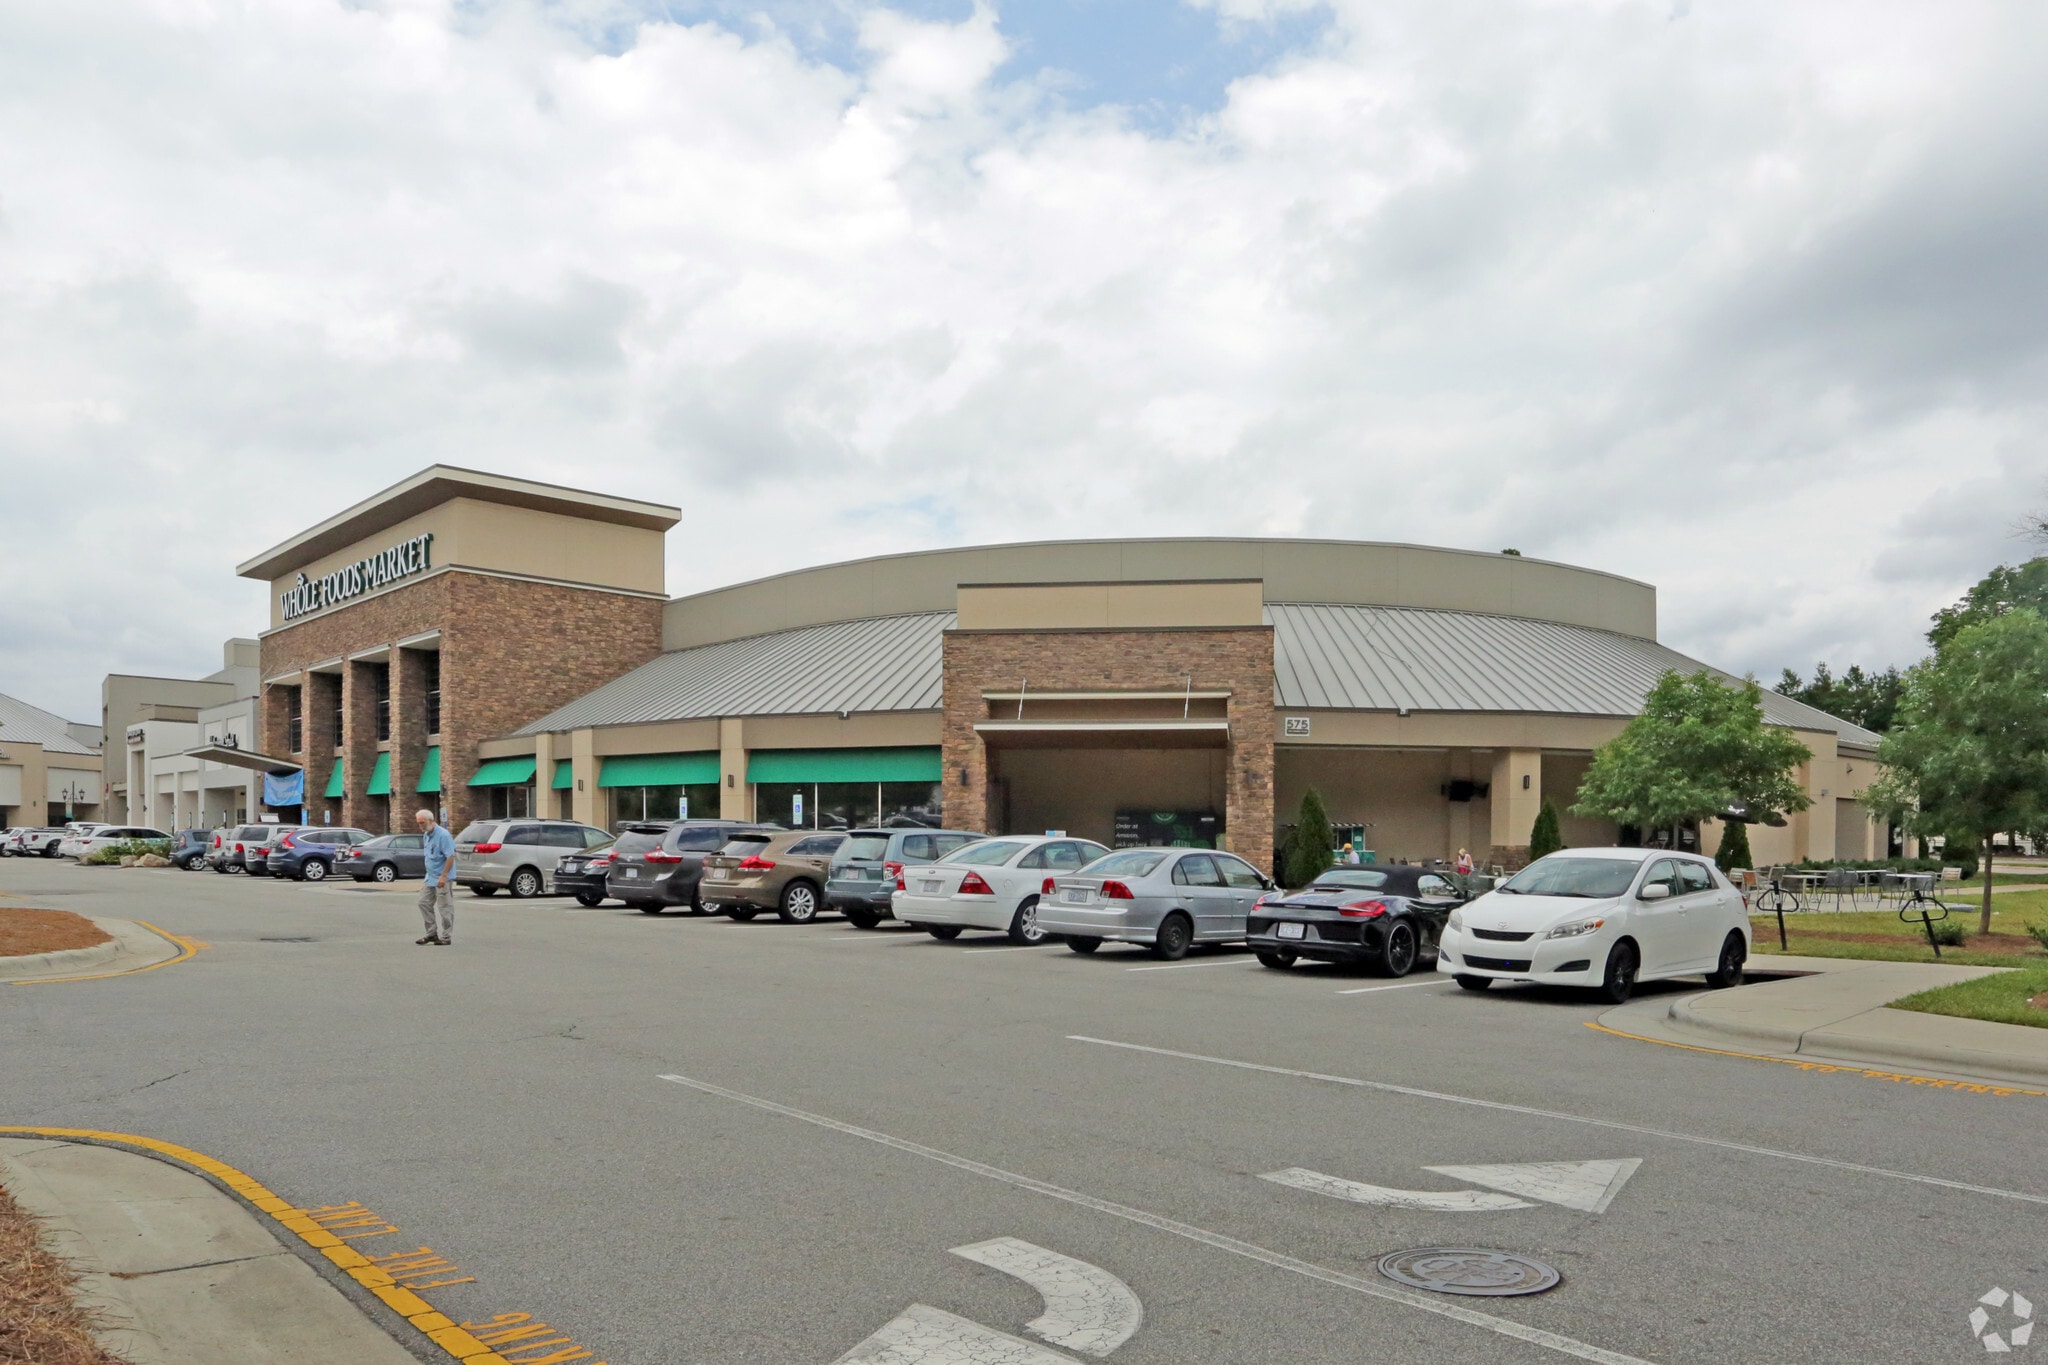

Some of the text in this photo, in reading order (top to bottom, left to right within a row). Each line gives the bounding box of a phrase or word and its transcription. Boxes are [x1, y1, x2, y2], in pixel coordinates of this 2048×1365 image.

[280, 533, 433, 620] WHOLE FOODS MARKET
[1287, 719, 1308, 729] 575
